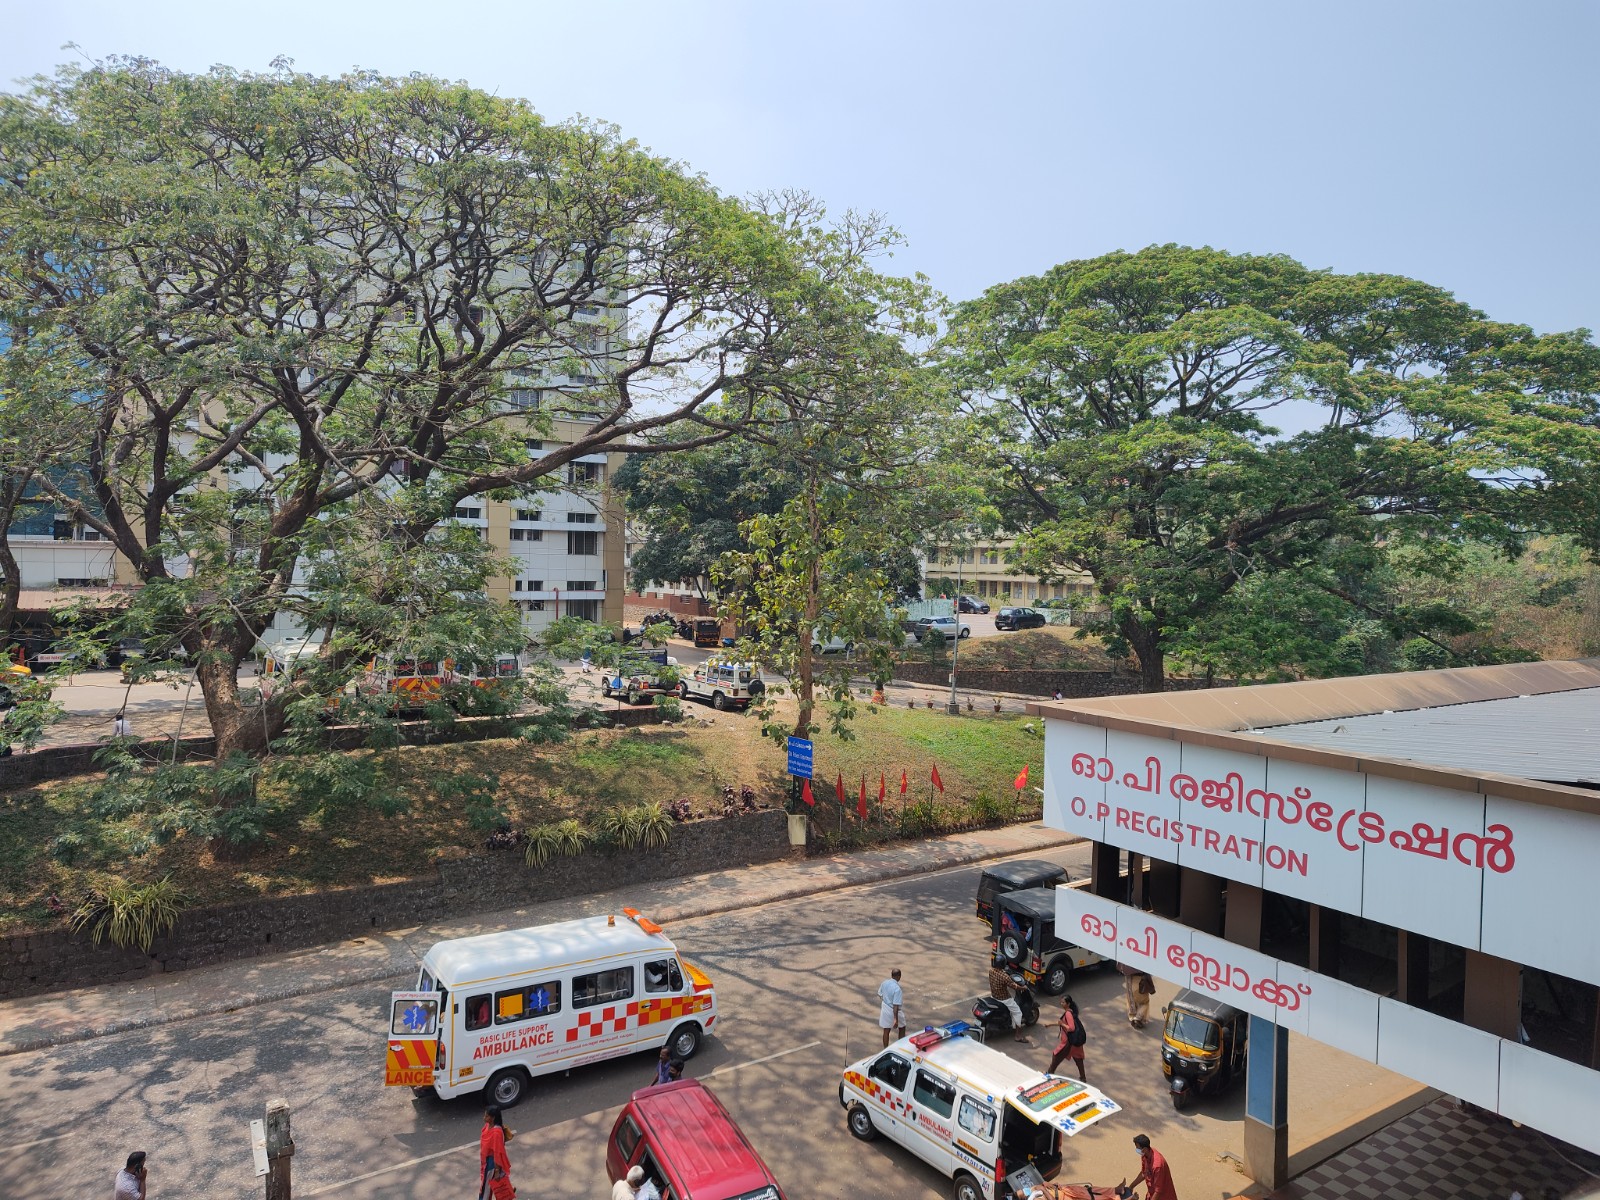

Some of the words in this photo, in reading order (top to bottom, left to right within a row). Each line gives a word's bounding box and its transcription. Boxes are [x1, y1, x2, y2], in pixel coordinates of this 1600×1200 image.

[1071, 752, 1161, 795] ഓ.പി
[1071, 796, 1111, 823] O.P
[1115, 805, 1309, 878] REGISTRATION
[1080, 912, 1159, 959] ഓ.പി
[1166, 943, 1312, 1013] ബ്ലോക്ക്
[473, 1031, 554, 1060] AMBULANCE
[480, 1034, 500, 1044] BASIC
[502, 1030, 516, 1040] LIFE
[518, 1023, 549, 1036] SUPPORT
[386, 1071, 432, 1085] LANCE
[1052, 1092, 1090, 1112] AMBULANCE
[919, 1113, 952, 1138] AMBULANCE
